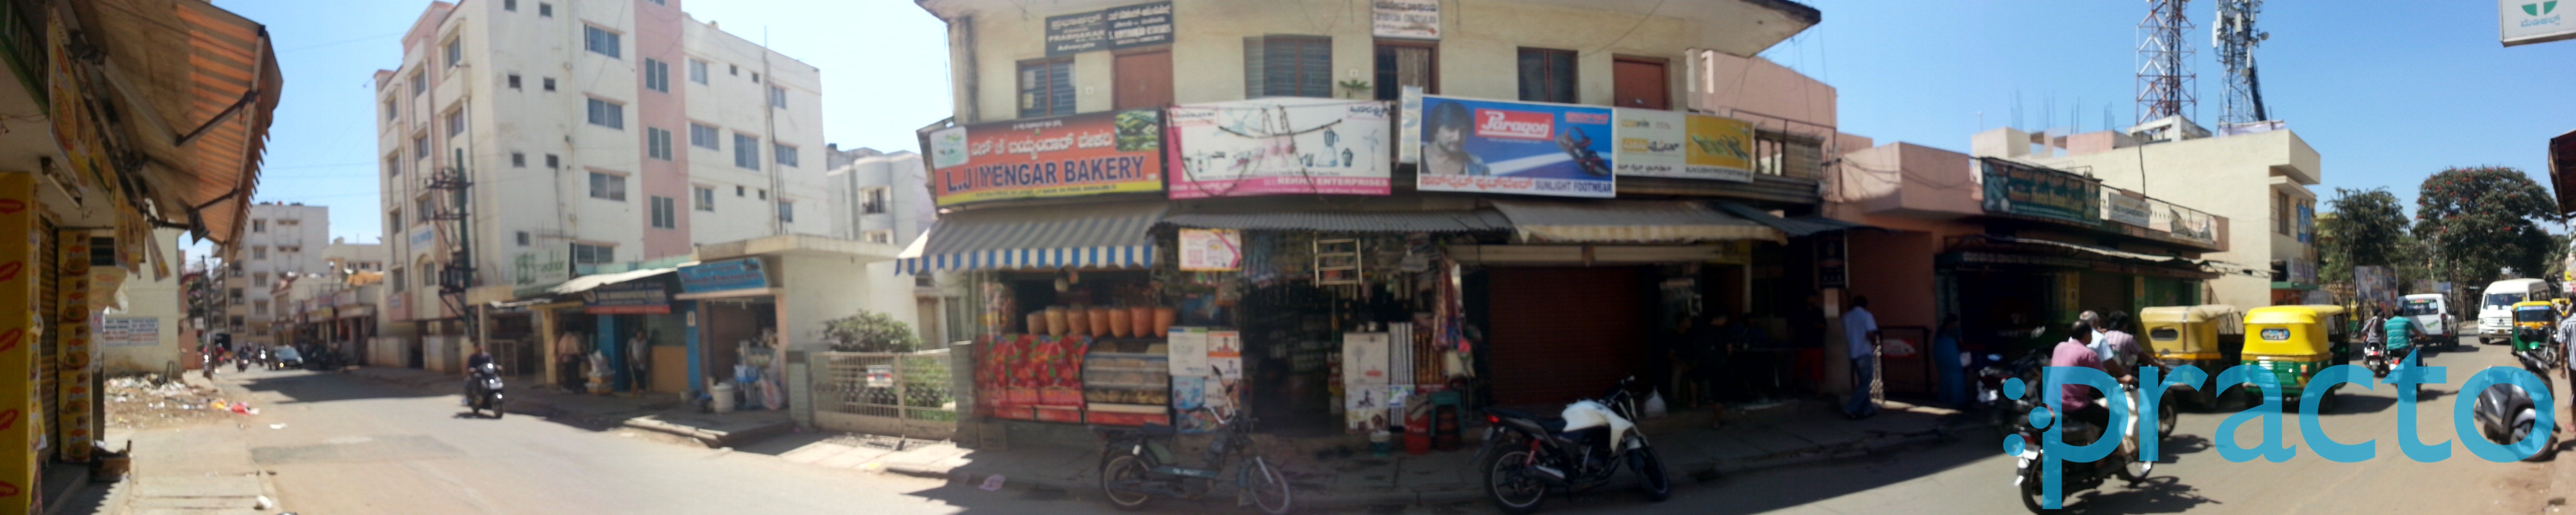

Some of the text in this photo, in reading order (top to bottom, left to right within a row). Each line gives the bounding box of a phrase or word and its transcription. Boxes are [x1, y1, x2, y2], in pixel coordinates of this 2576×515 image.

[1480, 111, 1550, 138] Paragon
[1064, 156, 1145, 183] BAKERY
[1573, 182, 1612, 193] FOOTWEAR
